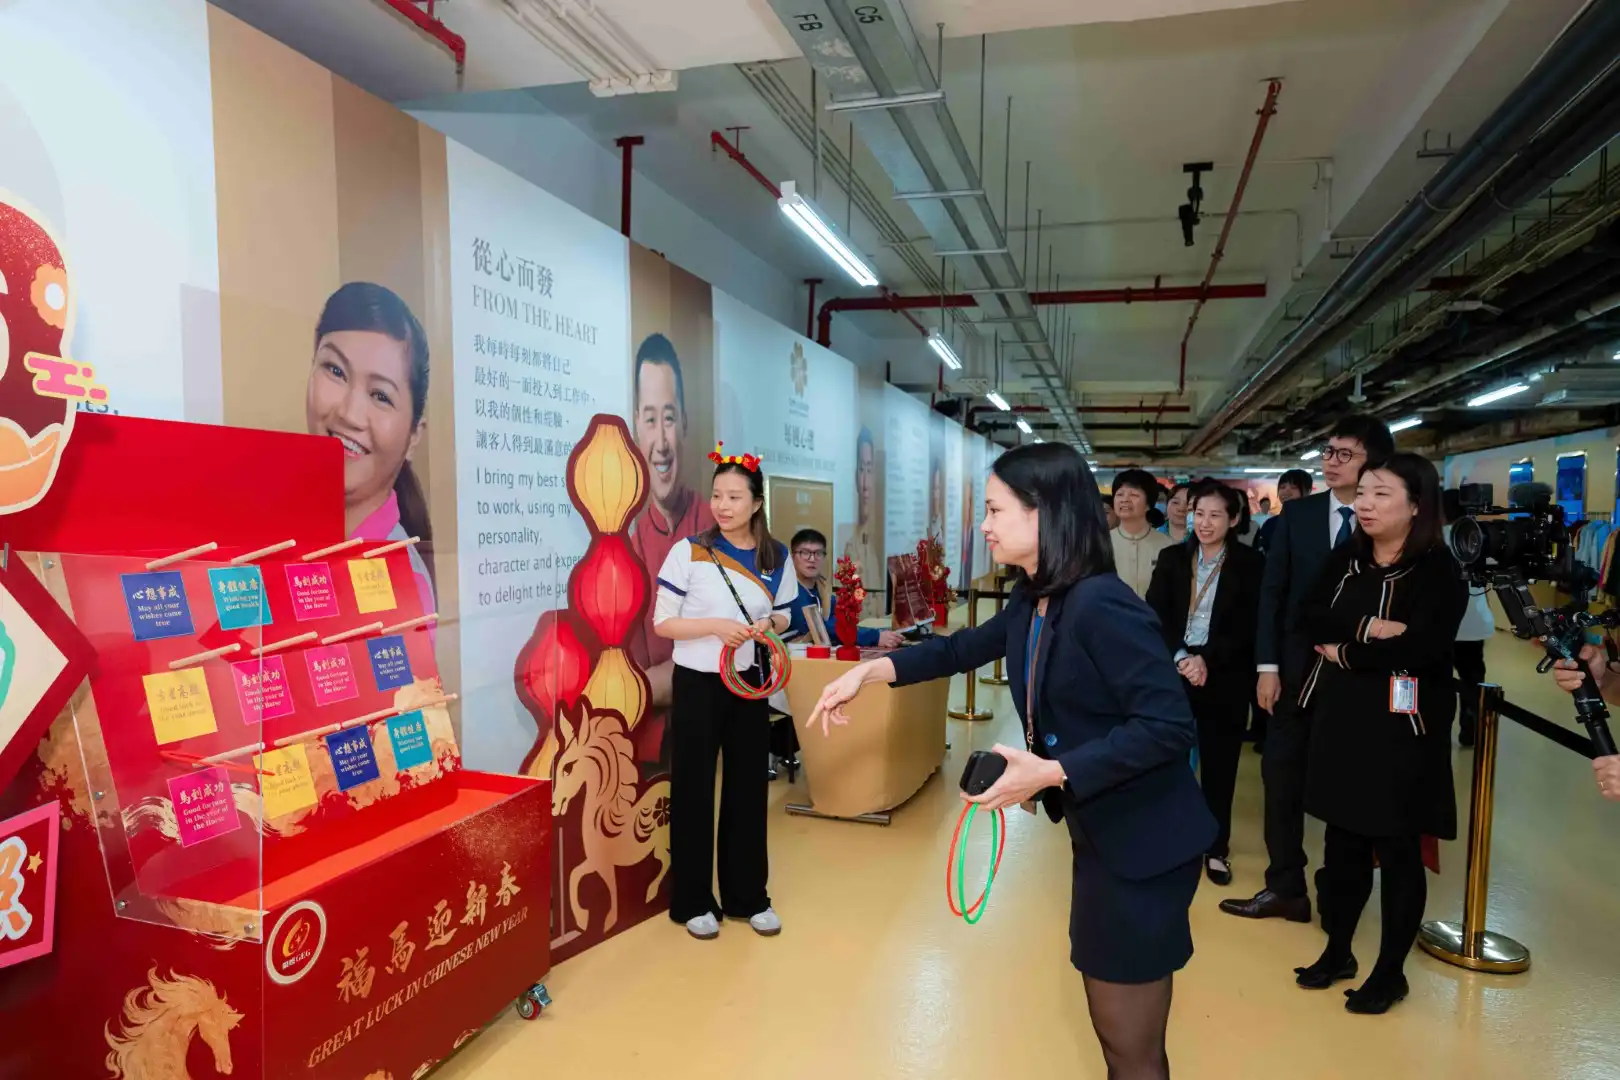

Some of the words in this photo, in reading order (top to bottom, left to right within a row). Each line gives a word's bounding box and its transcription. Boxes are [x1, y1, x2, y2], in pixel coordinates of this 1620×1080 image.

[471, 237, 554, 300] 從心而發
[471, 284, 518, 320] FROM
[521, 301, 552, 331] THE
[555, 313, 599, 345] HEART
[476, 428, 577, 456] 讓客人得到最滿意的
[476, 467, 480, 484] I
[484, 467, 514, 489] bring
[518, 473, 534, 490] my
[537, 471, 558, 488] best
[477, 500, 489, 515] to
[493, 498, 524, 516] work,
[528, 502, 555, 518] using
[558, 503, 572, 517] my
[478, 557, 531, 575] character
[533, 553, 552, 570] and
[132, 584, 180, 601] 心想事成
[479, 591, 491, 606] to
[495, 585, 533, 604] delight
[536, 581, 552, 597] the
[137, 604, 151, 613] May
[153, 603, 163, 611] all
[164, 602, 180, 611] your
[139, 612, 162, 620] wishes
[335, 737, 368, 755] 心想事成
[179, 781, 224, 805] 馬到成功
[183, 804, 201, 816] Good
[202, 798, 228, 809] fortune
[185, 817, 193, 825] in
[194, 813, 206, 822] the
[221, 804, 229, 812] of
[193, 822, 205, 831] the
[206, 816, 225, 826] Horse
[336, 860, 521, 1004] 福馬迎新春
[308, 1016, 365, 1068] GREAT
[365, 988, 405, 1029] LUCK
[405, 977, 422, 1002] IN
[423, 942, 476, 989] CHINESE
[475, 923, 502, 955] NEW
[502, 906, 528, 935] YEAR
